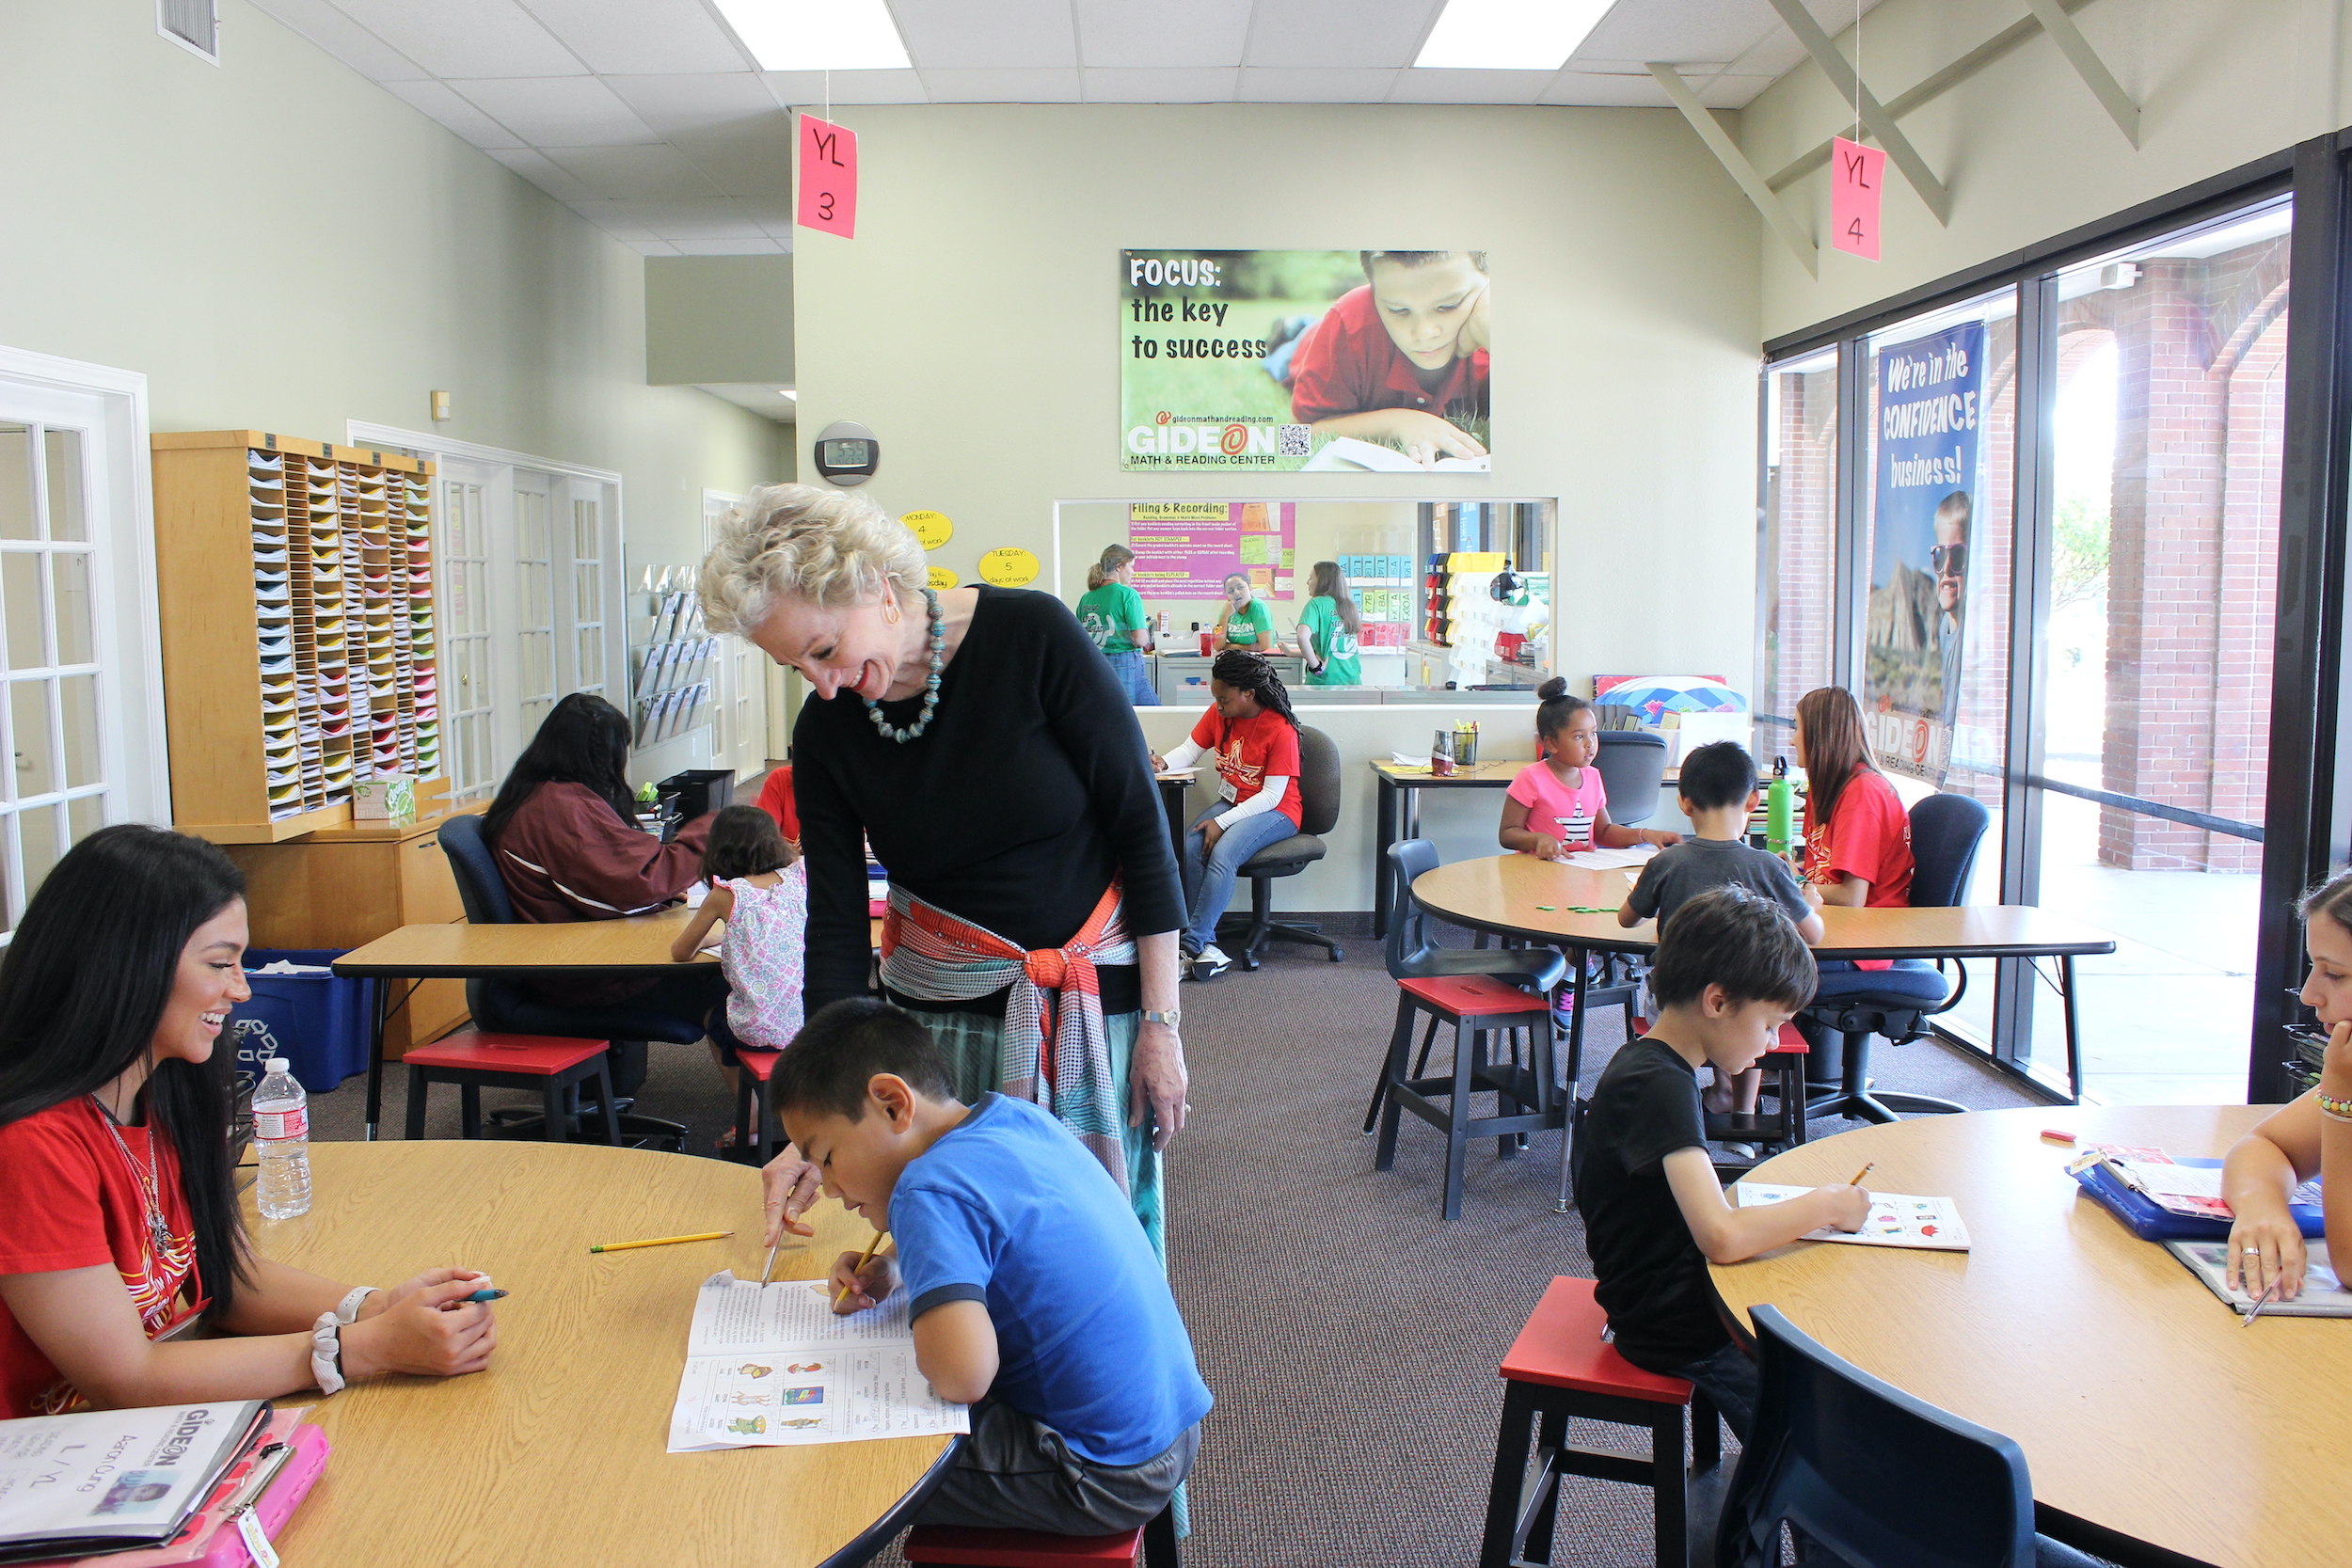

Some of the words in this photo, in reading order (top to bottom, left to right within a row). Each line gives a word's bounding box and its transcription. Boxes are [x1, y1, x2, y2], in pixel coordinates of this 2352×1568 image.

[813, 128, 845, 167] YL
[1844, 150, 1870, 189] YL
[818, 192, 834, 221] 3
[1848, 216, 1864, 245] 4
[1130, 258, 1221, 289] FOCUS:
[1131, 295, 1174, 324] the
[1182, 295, 1229, 327] key
[1131, 334, 1158, 359] to
[1166, 337, 1267, 359] success
[1886, 354, 1927, 394] We're
[1929, 361, 1942, 387] in
[1944, 342, 1969, 380] the
[1171, 415, 1274, 424] gideonmathandreading.com
[1883, 389, 1977, 442] CONFIDENCE
[1130, 455, 1162, 465] MATH
[1165, 455, 1173, 465] &
[1176, 455, 1227, 465] READING
[1233, 455, 1276, 465] CENTER
[1890, 444, 1962, 490] business!
[905, 513, 937, 521] MONDAY:
[1132, 502, 1160, 515] Filing
[1163, 502, 1170, 514] &
[1173, 502, 1228, 515] Recording:
[917, 525, 927, 533] 4
[927, 537, 944, 546] work
[1005, 562, 1012, 571] 5
[1884, 755, 1915, 774] READING
